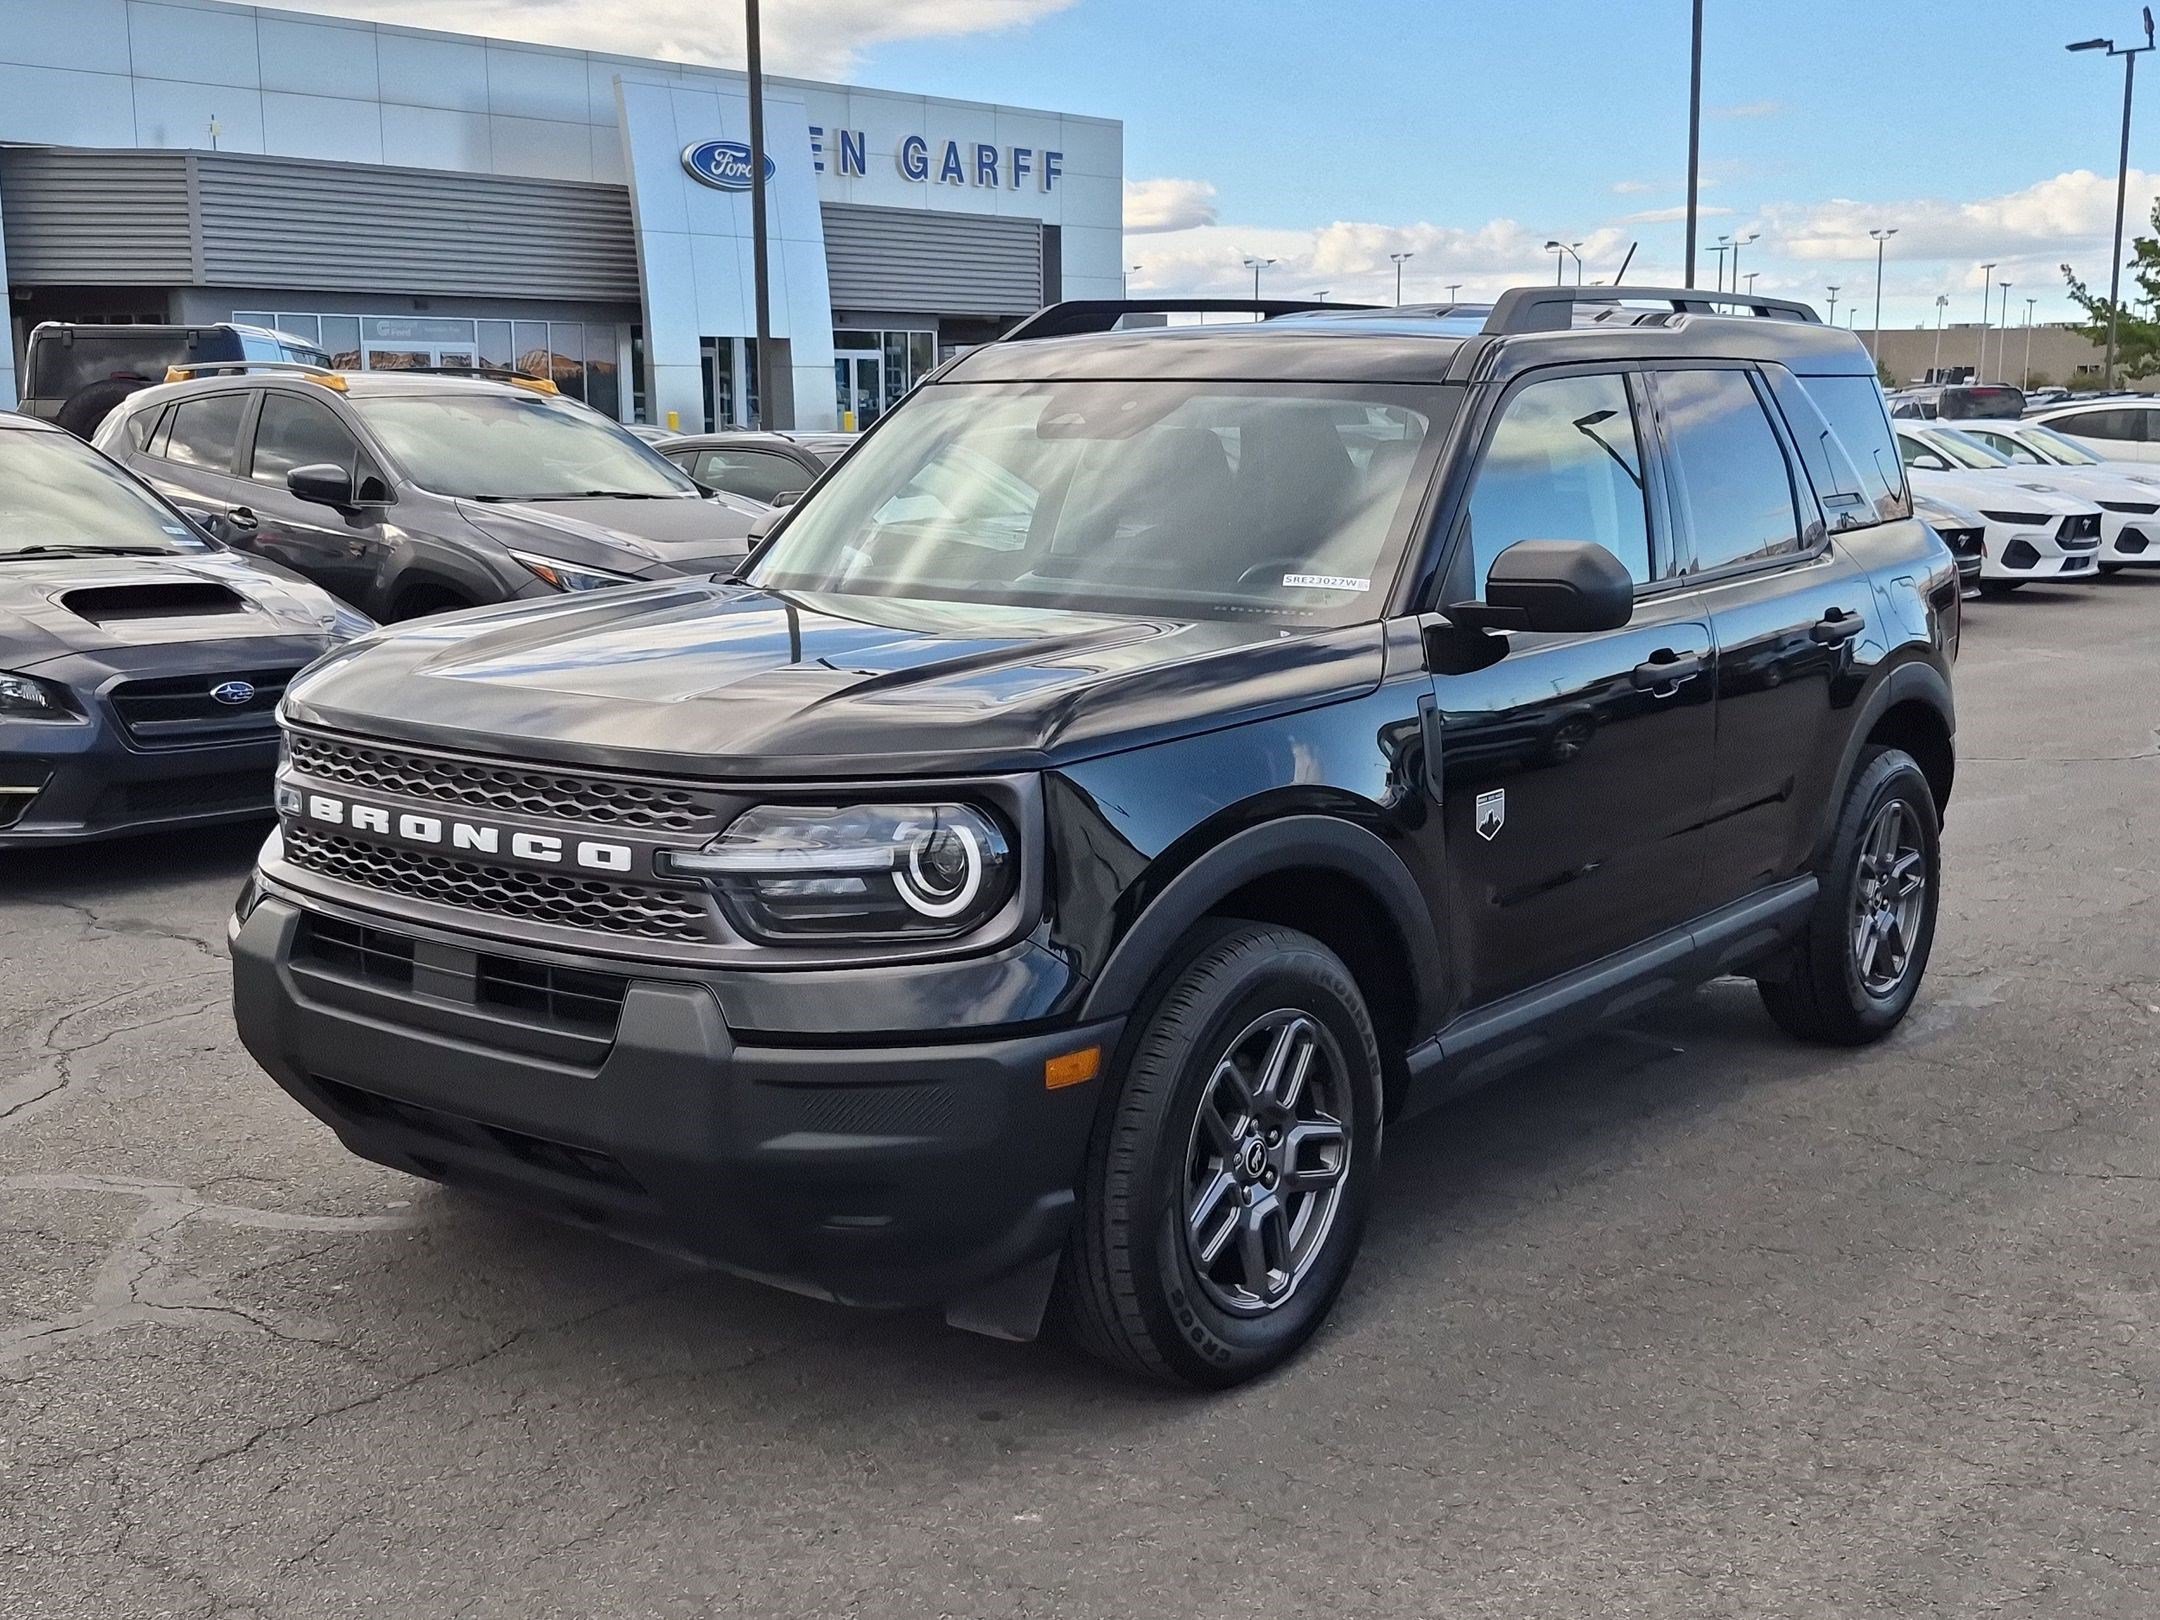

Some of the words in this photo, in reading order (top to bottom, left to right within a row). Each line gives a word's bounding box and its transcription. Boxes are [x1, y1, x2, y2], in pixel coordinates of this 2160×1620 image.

[900, 134, 1064, 194] GARFF
[1285, 575, 1358, 587] SRE23027W
[310, 795, 632, 872] BRONCO
